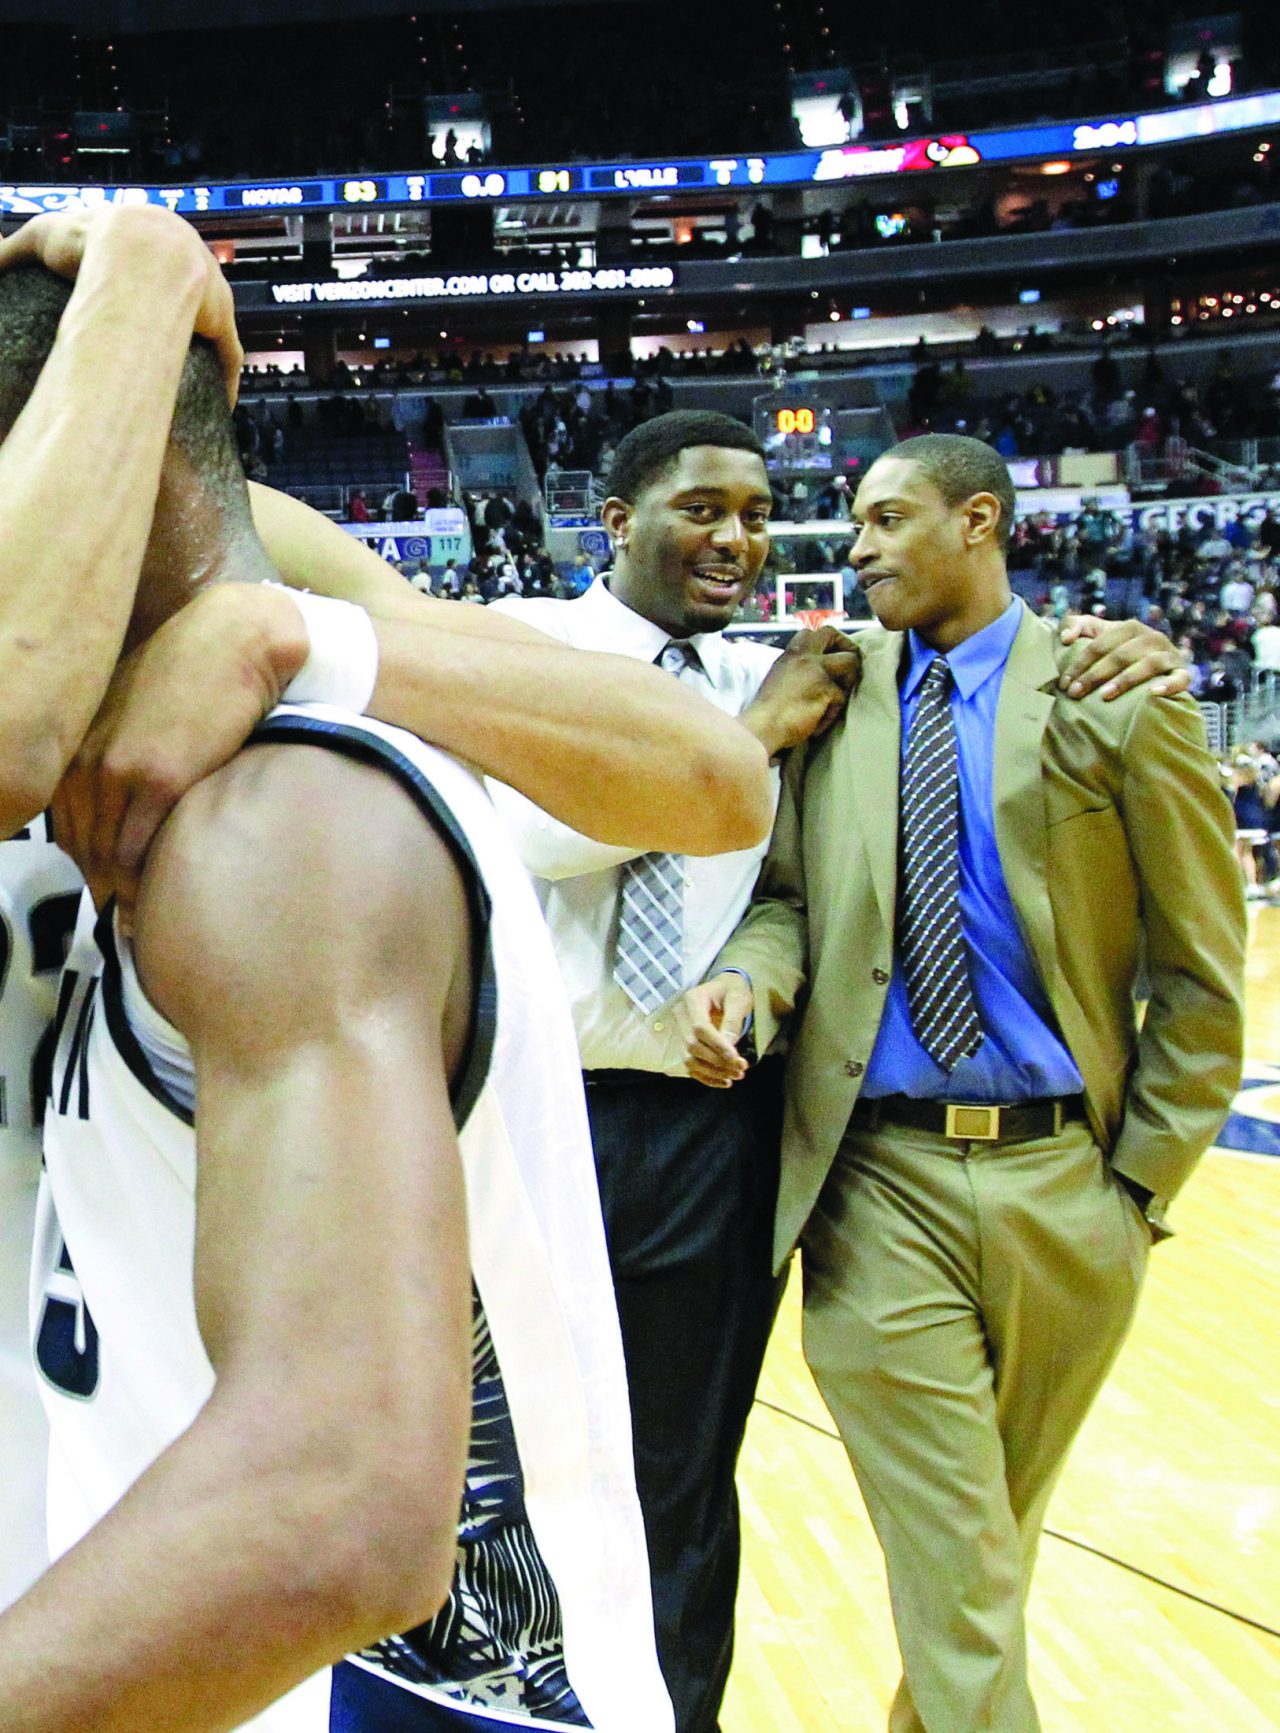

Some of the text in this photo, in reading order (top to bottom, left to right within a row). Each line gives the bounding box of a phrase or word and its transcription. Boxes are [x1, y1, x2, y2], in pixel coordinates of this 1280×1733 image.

[272, 283, 314, 302] VISIT
[488, 274, 516, 294] OR
[516, 272, 559, 293] CALL
[439, 537, 462, 551] 117
